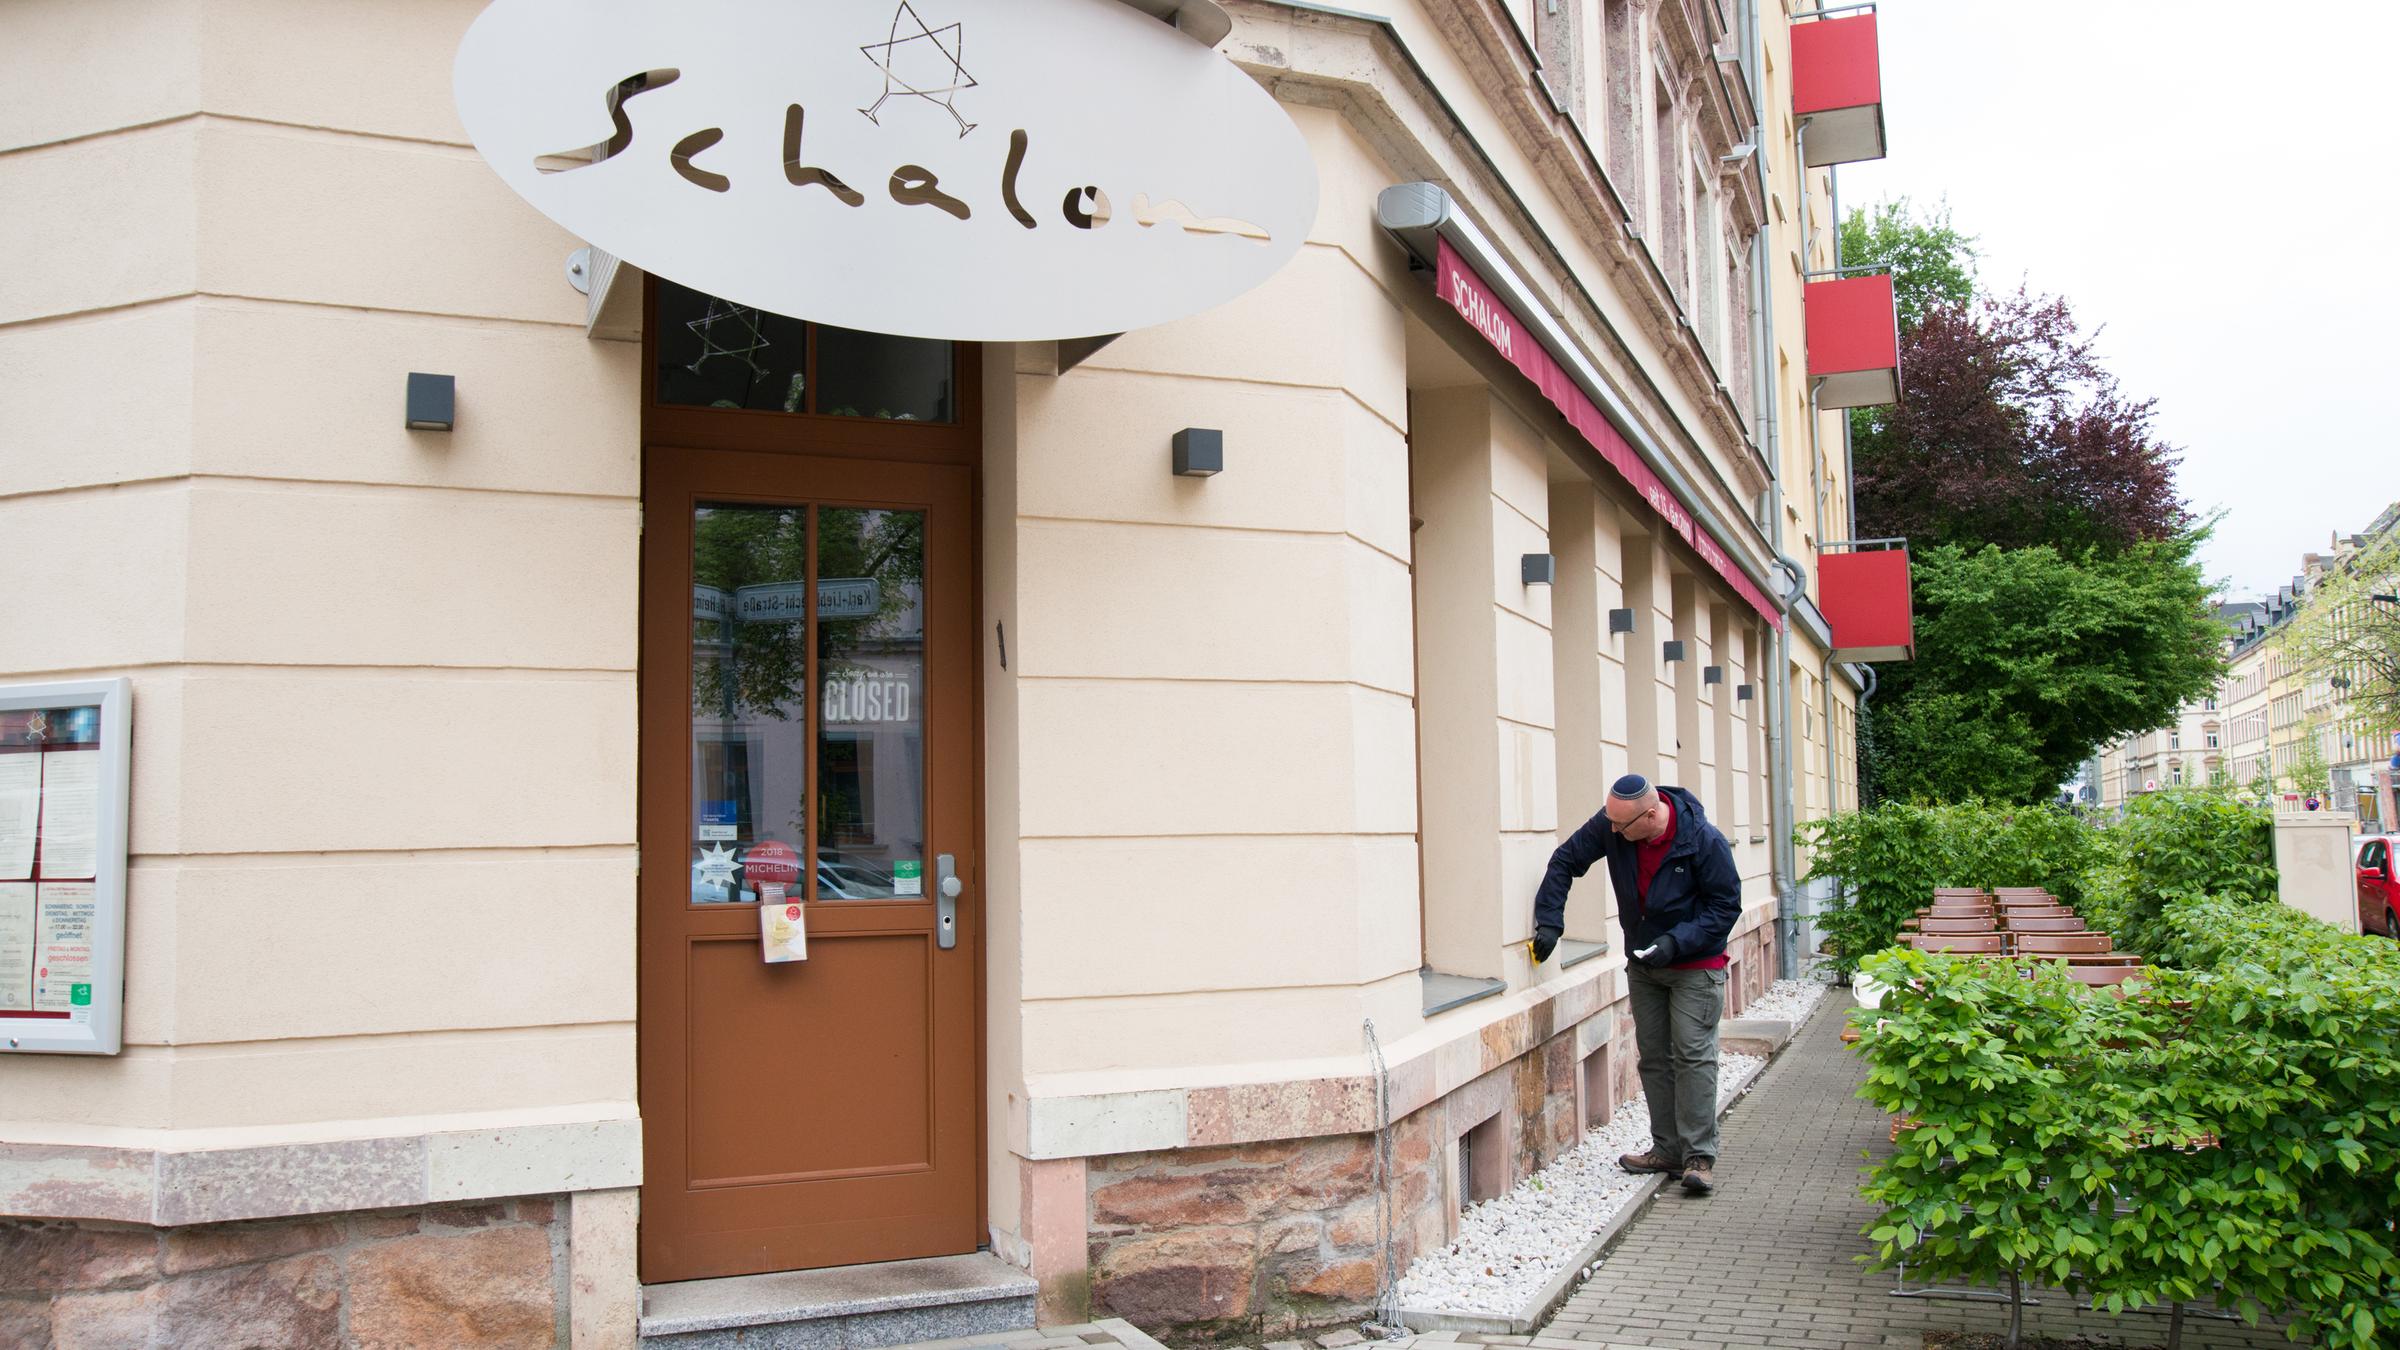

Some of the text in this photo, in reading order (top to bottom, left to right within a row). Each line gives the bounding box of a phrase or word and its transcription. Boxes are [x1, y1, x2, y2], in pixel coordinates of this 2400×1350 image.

[533, 66, 1272, 247] Schalom
[1452, 270, 1512, 358] SCHALOM
[825, 679, 910, 722] CLOSED
[760, 848, 783, 856] 2018
[745, 864, 798, 873] MICHELIN
[56, 930, 82, 941] geöffnet
[48, 953, 89, 963] geschlossen
